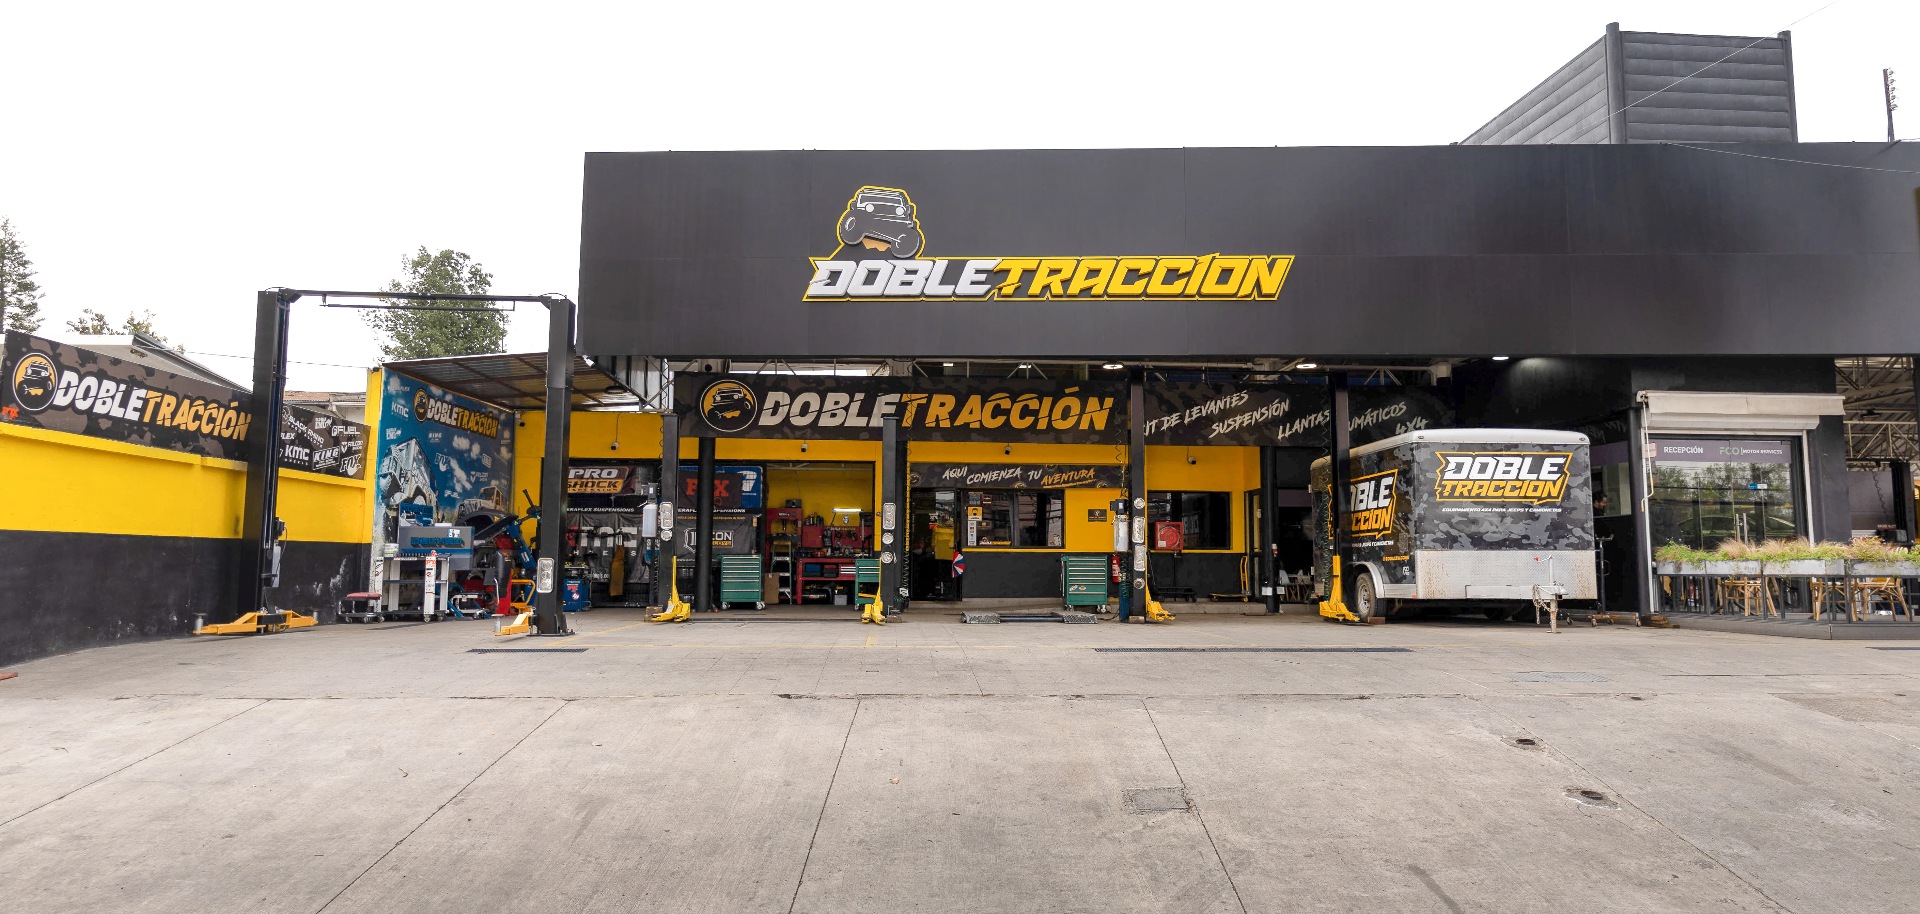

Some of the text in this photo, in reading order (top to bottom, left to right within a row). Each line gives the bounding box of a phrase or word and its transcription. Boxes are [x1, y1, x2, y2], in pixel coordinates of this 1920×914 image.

[53, 370, 252, 441] DOBLETRACCIÓN
[427, 398, 499, 438] DOBLETRACCIÓN
[758, 386, 1114, 431] DOBLETRACCIÓN
[1143, 390, 1249, 437] IT DE LEVANTES
[1208, 397, 1289, 439] SUSPENSIÓN
[1349, 402, 1407, 431] UMÁTICOS
[289, 415, 324, 444] BLACK RHINO
[1278, 409, 1329, 441] LLANTAS
[285, 444, 310, 461] KMC
[314, 448, 339, 462] KING
[1663, 446, 1703, 454] RECEPCIÓN
[568, 469, 618, 478] PRO
[966, 467, 1022, 485] COMIENZA
[1028, 469, 1043, 482] TU
[1040, 468, 1096, 486] AVENTURA
[1443, 456, 1566, 480] DOBLE
[686, 478, 729, 496] FX
[1350, 476, 1394, 511] BLE
[1351, 498, 1393, 531] CCION
[410, 537, 463, 546] DECKED
